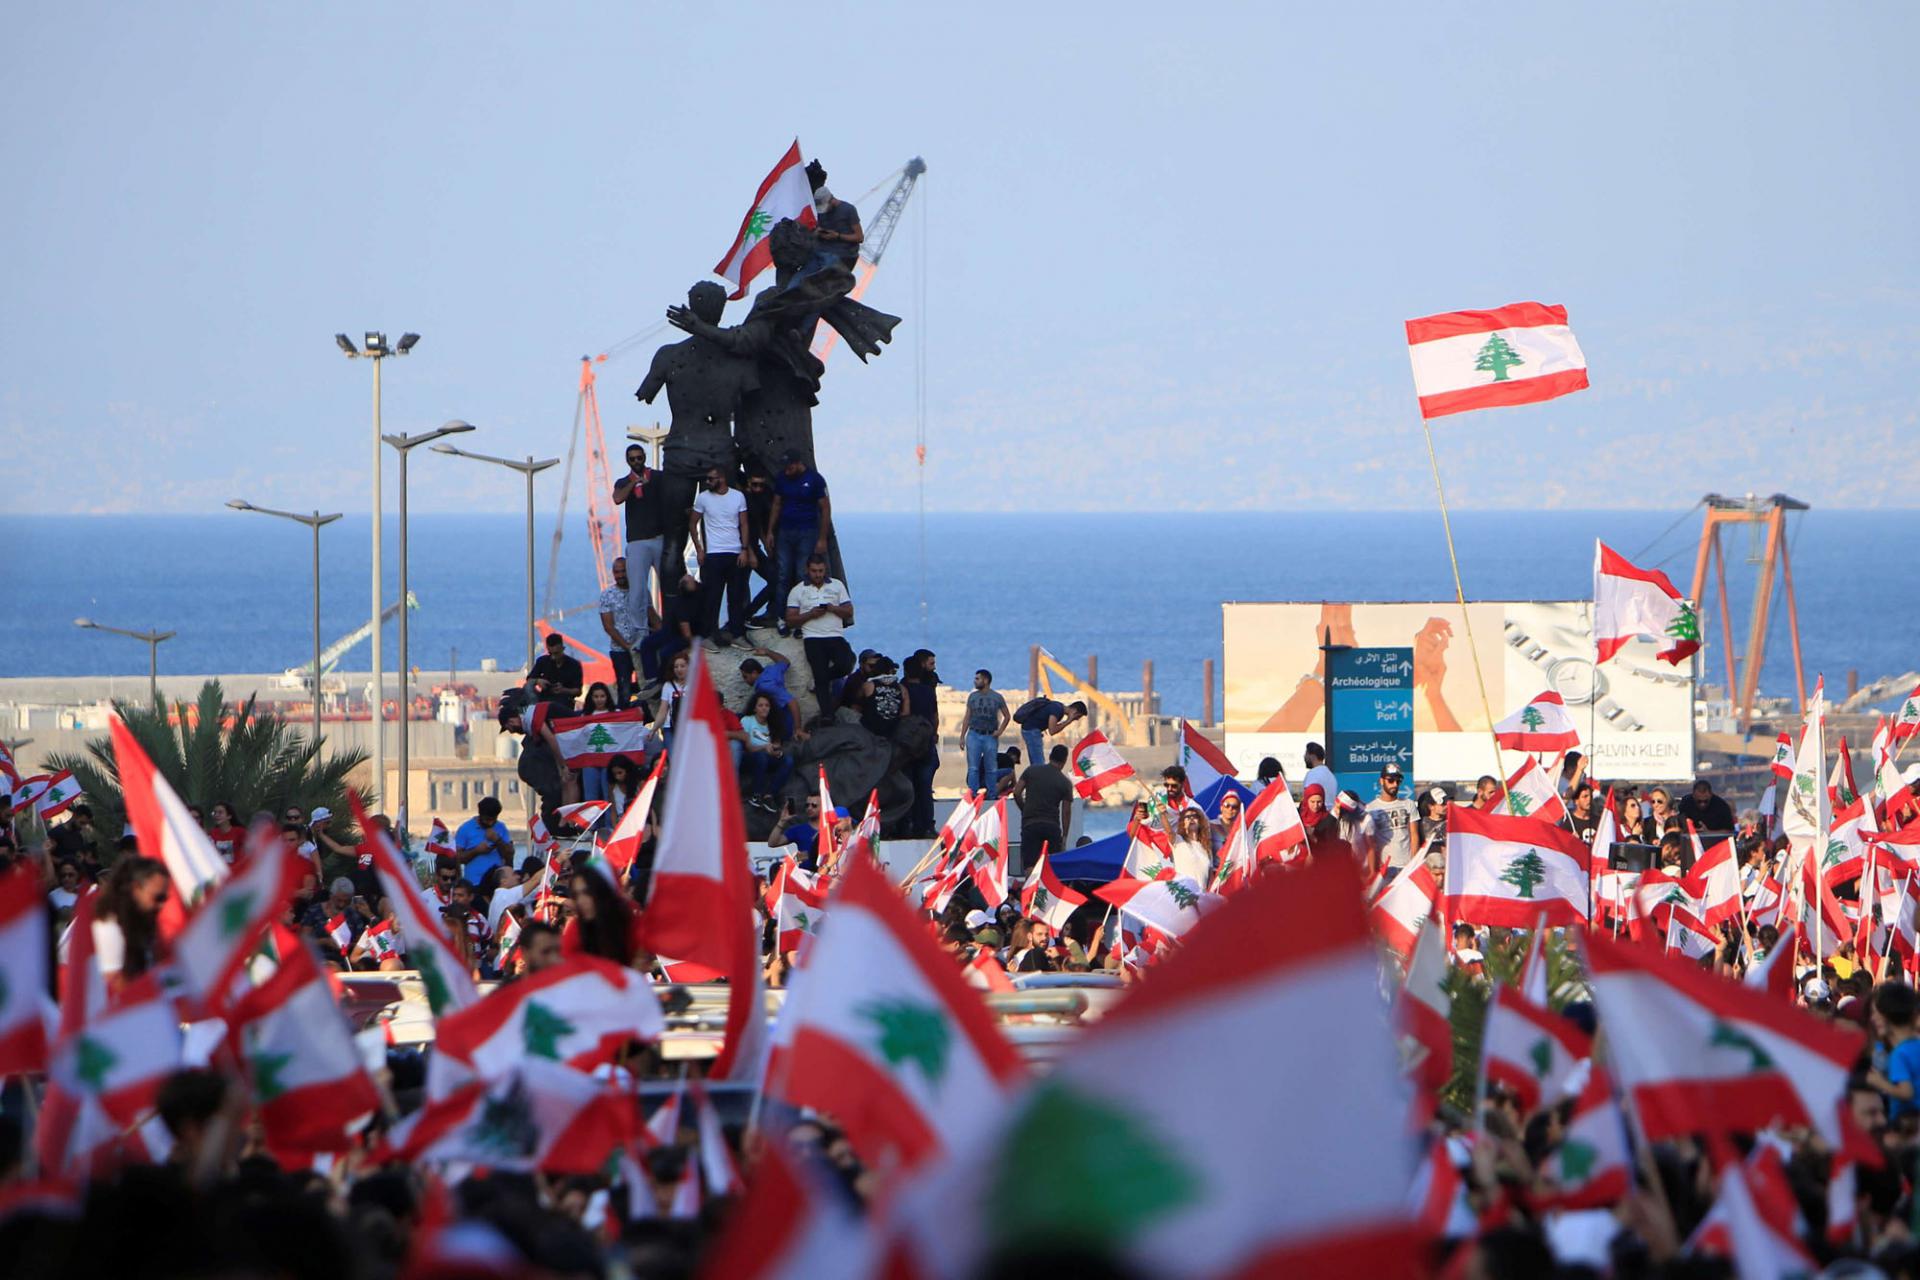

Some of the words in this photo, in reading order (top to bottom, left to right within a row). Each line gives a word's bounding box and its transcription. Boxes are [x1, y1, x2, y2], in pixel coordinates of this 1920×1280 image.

[1380, 664, 1397, 673] Tell
[1331, 676, 1401, 688] Archéologique
[1376, 711, 1397, 720] Port
[1583, 743, 1636, 758] CALVIN
[1639, 743, 1680, 758] KLEIN
[1350, 753, 1369, 763] Bab
[1370, 753, 1397, 763] Idriss
